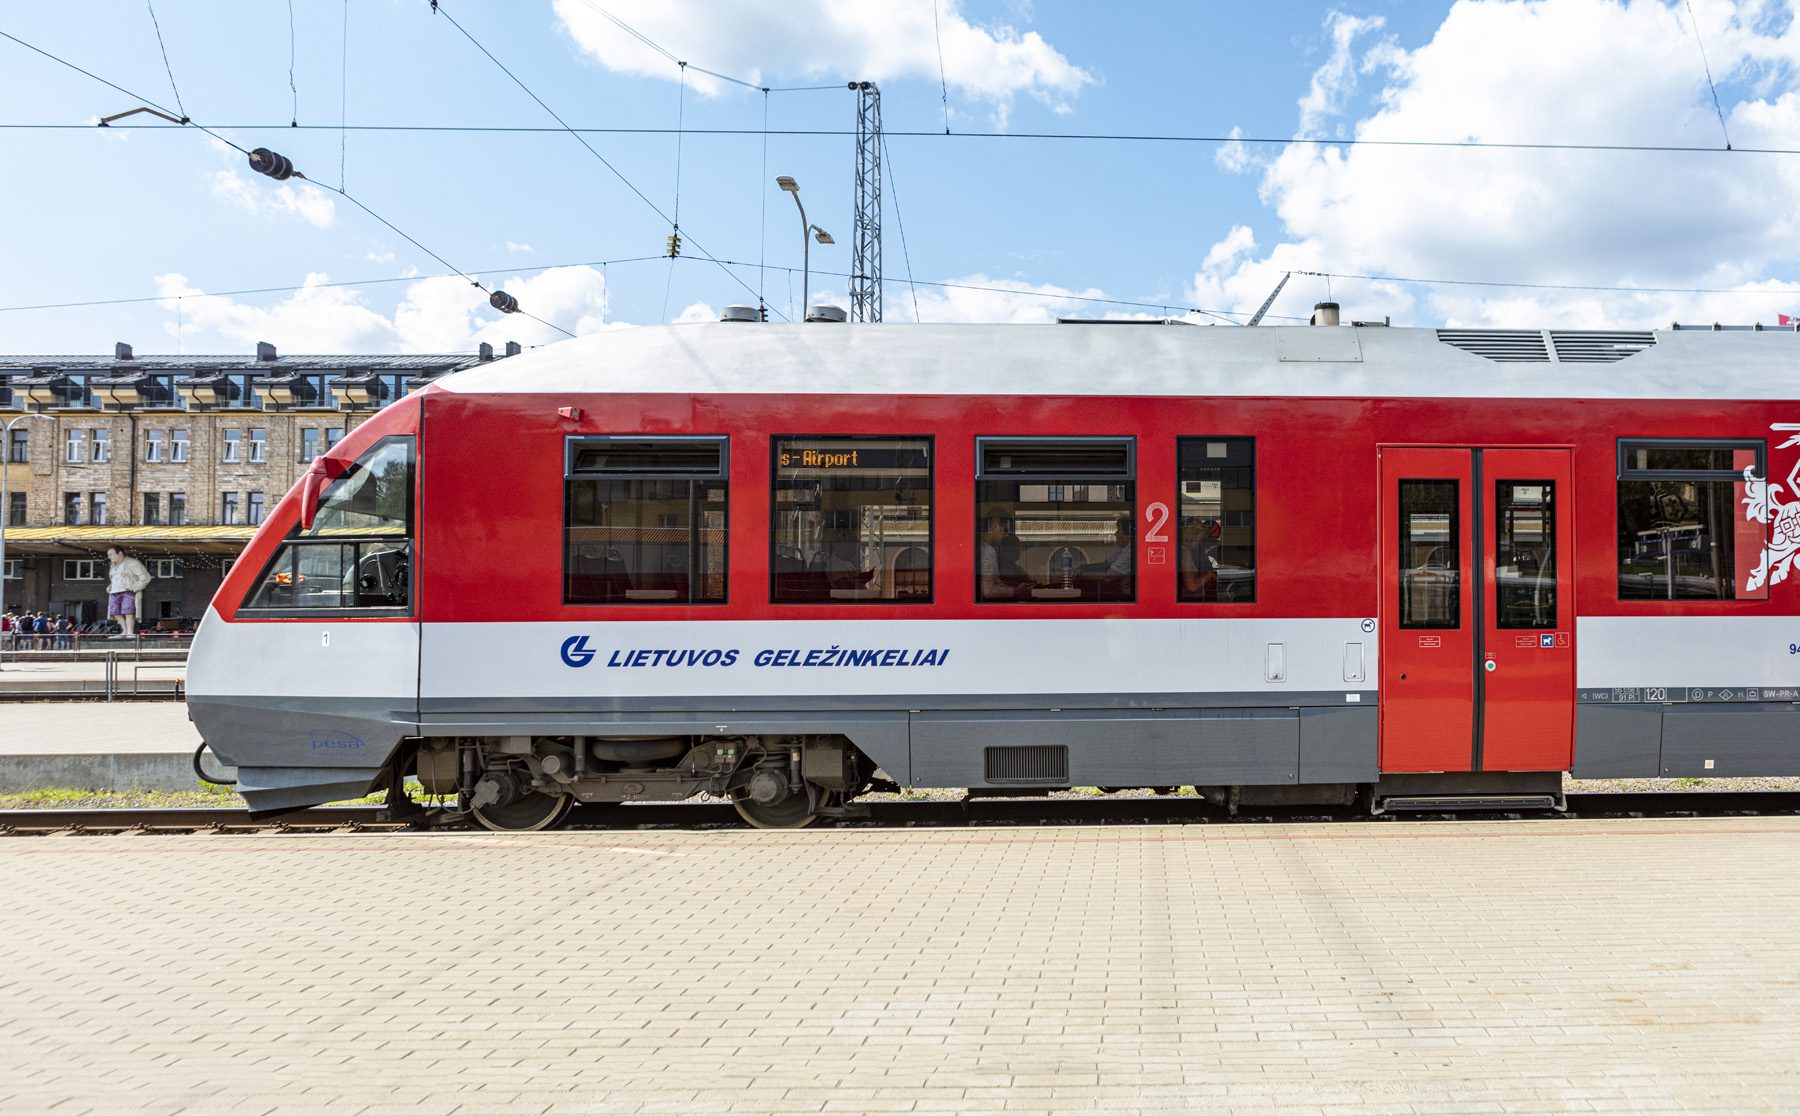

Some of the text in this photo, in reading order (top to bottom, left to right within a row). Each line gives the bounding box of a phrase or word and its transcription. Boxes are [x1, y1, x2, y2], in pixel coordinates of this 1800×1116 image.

[1145, 501, 1169, 543] 2
[606, 645, 951, 667] LIETUVOS GELEŽINKELIAI
[1592, 692, 1609, 700] (WC)
[1646, 688, 1665, 700] 120
[311, 739, 361, 751] pesa
